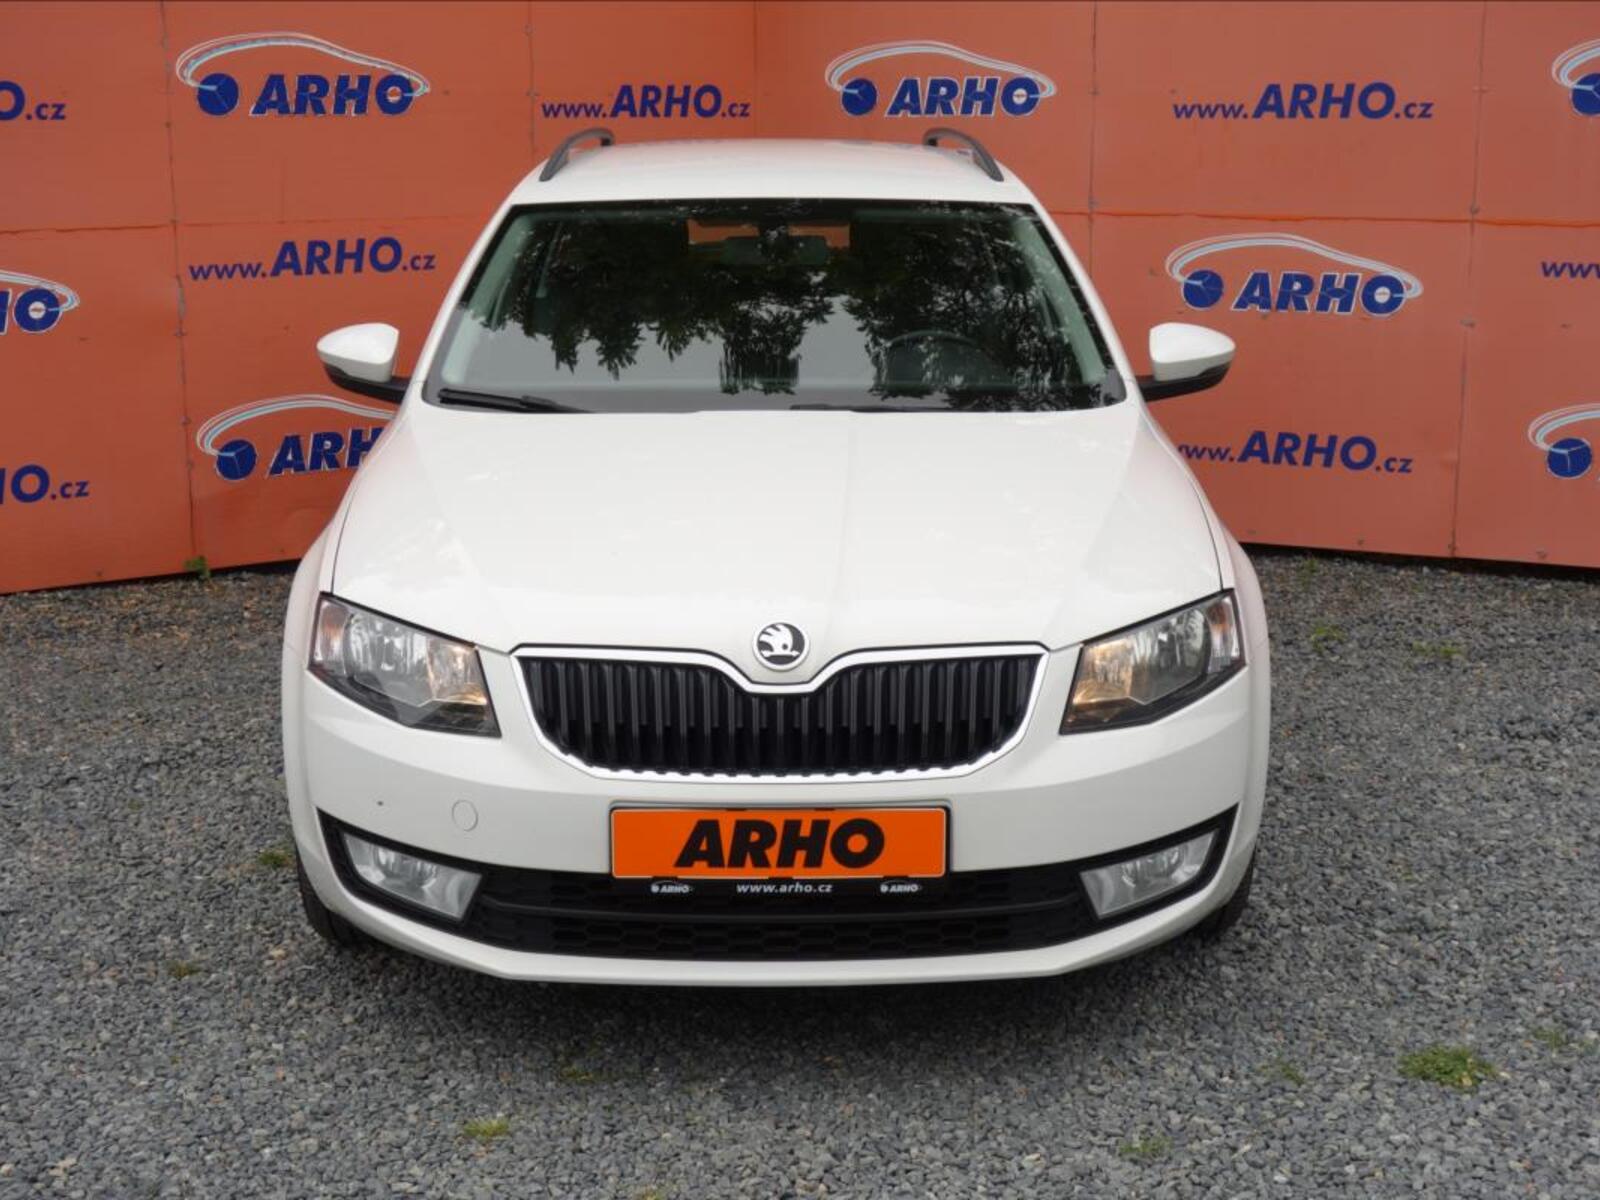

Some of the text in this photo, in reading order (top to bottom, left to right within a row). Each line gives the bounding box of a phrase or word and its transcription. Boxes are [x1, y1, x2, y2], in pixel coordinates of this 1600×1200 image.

[250, 73, 413, 116] ARHO
[542, 84, 750, 119] www.ARHO.cz
[886, 77, 1040, 117] ARHO
[1173, 81, 1434, 120] www.ARHO.cz
[189, 236, 436, 280] www.ARHO.cz
[1541, 261, 1600, 279] ww
[0, 287, 62, 333] O
[1232, 272, 1405, 314] ARHO
[1178, 430, 1413, 474] ww.ARHO.cz
[0, 464, 90, 504] O.cz
[674, 818, 885, 869] ARHO
[660, 884, 690, 893] ARHO
[736, 883, 833, 894] www.arho.cz
[889, 884, 919, 893] ARHO
